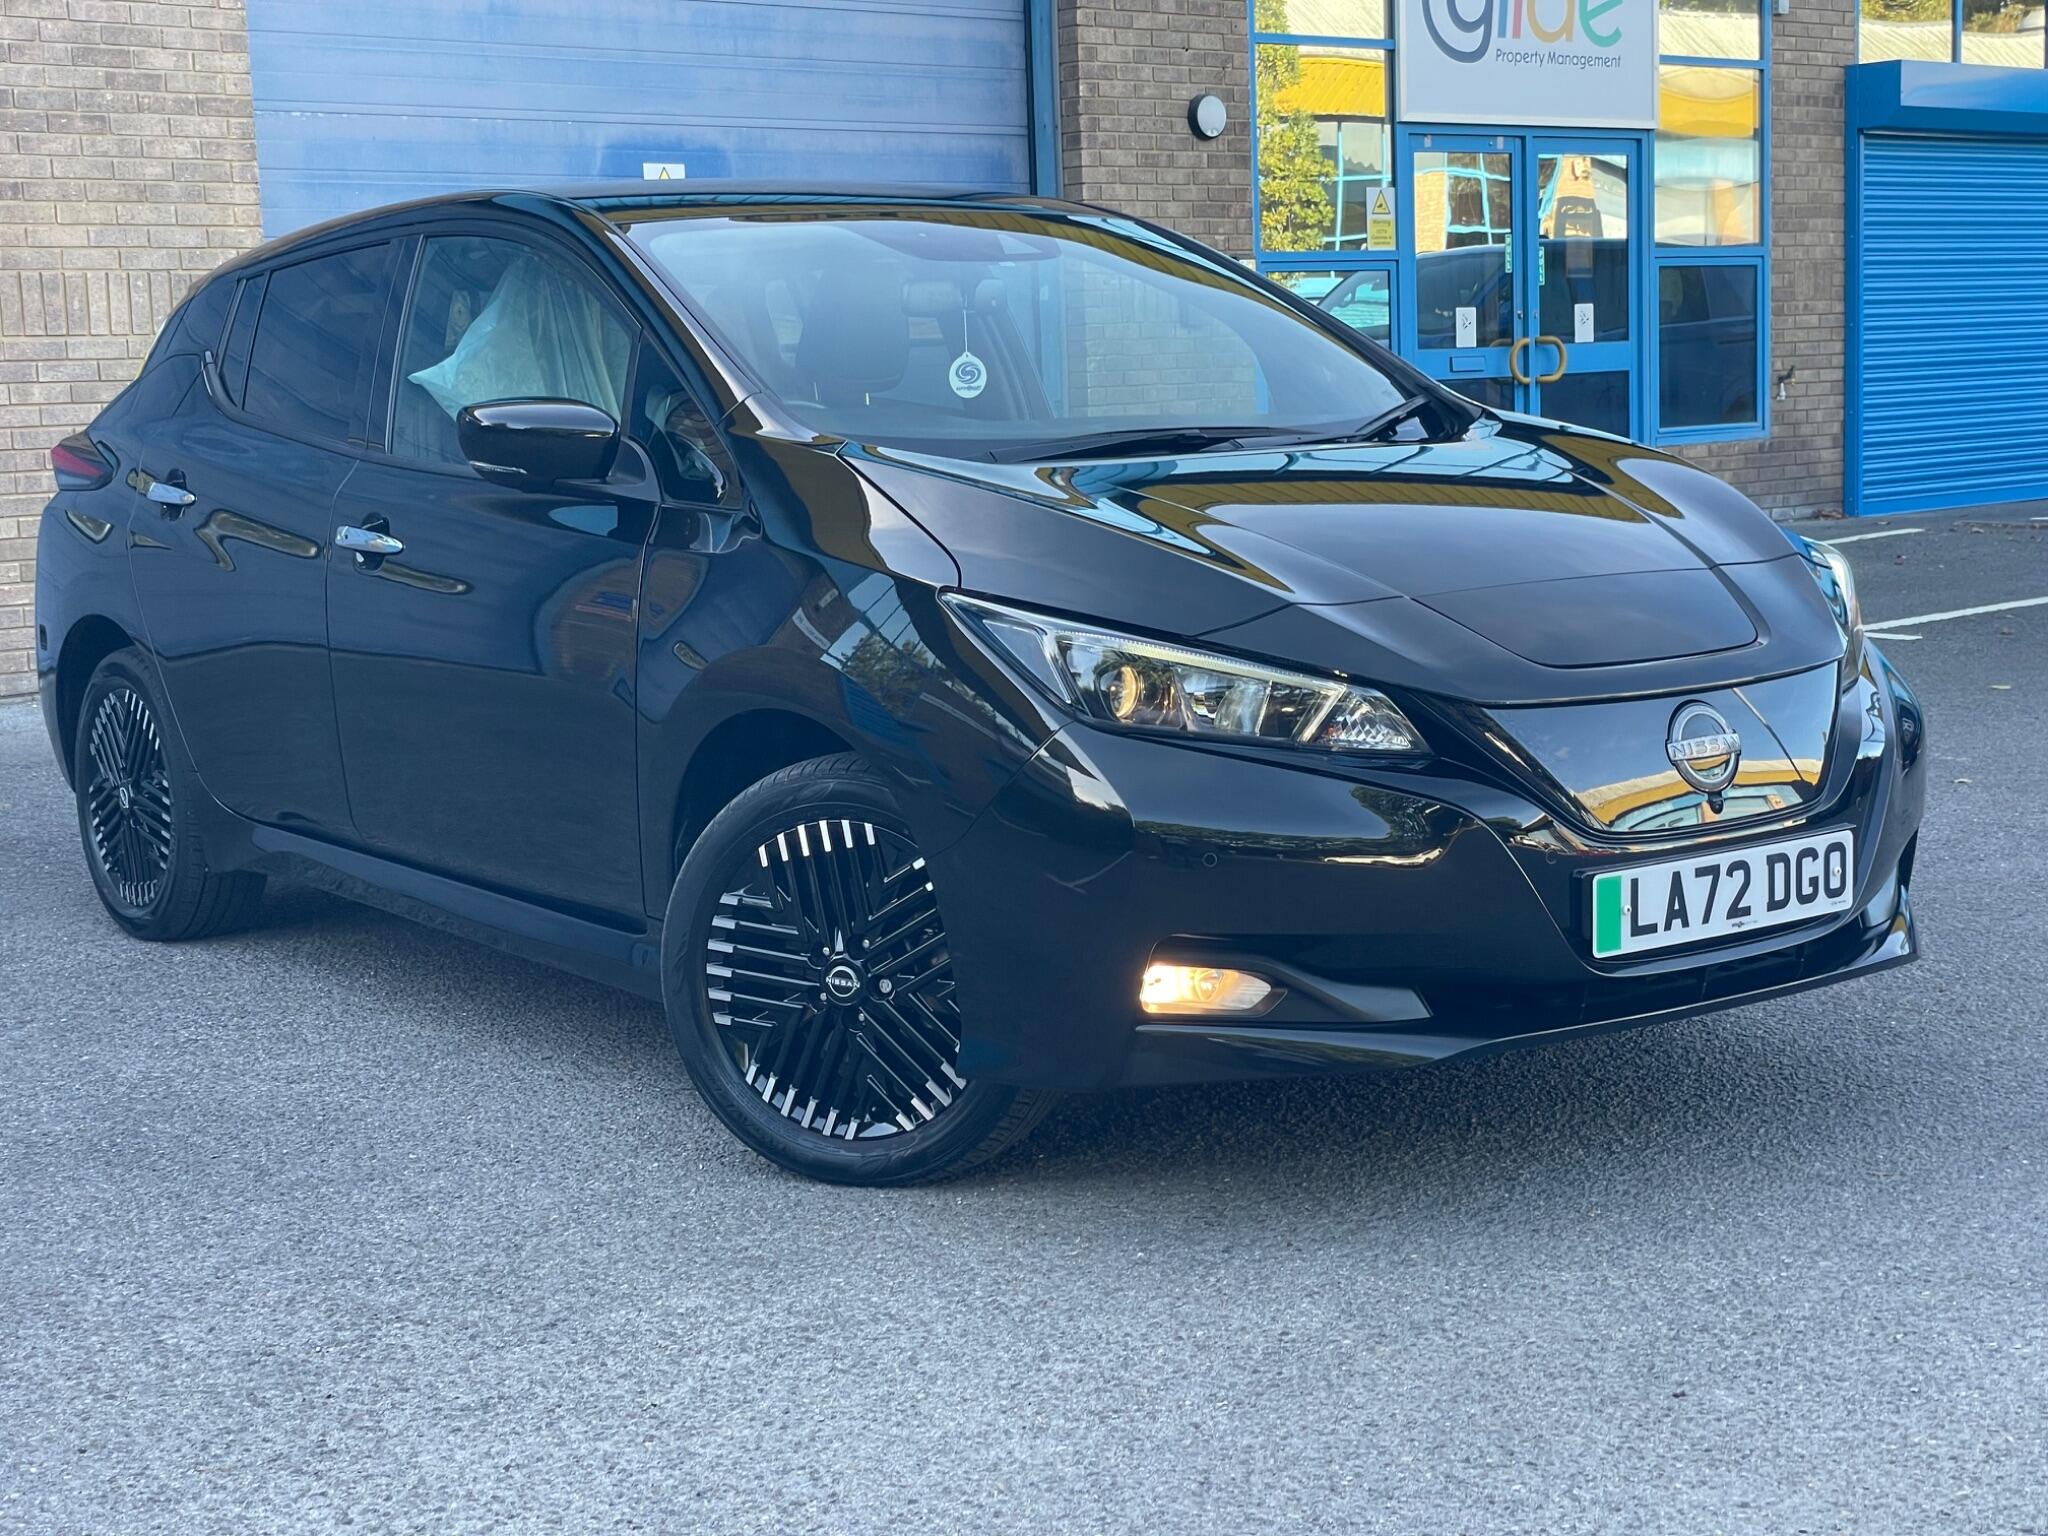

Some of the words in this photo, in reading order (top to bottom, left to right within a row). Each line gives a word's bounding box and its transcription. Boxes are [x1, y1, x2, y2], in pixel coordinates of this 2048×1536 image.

[1495, 48, 1545, 67] Property
[1547, 51, 1621, 69] Management
[1671, 735, 1739, 758] NISSAN
[1630, 859, 1752, 938] LA72
[1766, 841, 1848, 913] DGO
[826, 977, 860, 988] NISSAN
